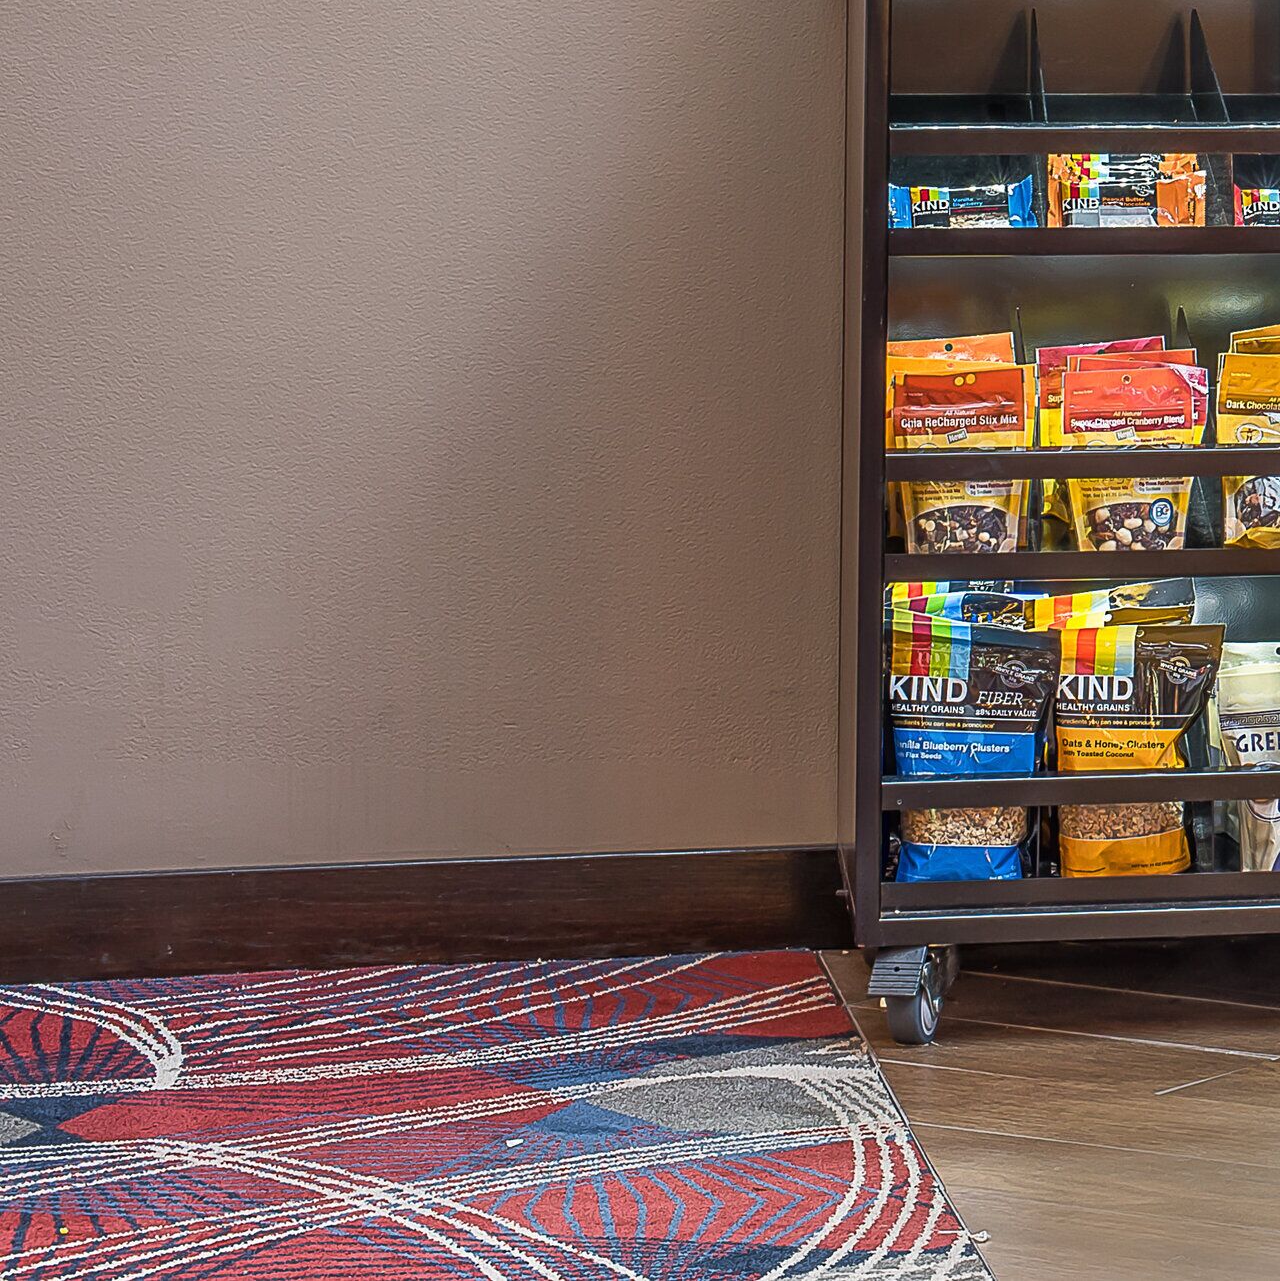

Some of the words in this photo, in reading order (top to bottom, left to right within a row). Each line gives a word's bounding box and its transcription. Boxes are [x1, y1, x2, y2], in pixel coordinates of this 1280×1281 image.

[912, 200, 950, 213] KIND
[1243, 202, 1280, 215] KIND
[1226, 400, 1246, 409] Dark
[925, 416, 977, 428] ReCharged
[979, 416, 997, 426] Stix
[1000, 414, 1018, 424] Mix
[1127, 417, 1162, 426] Cranberry
[1163, 415, 1186, 424] Blend
[1160, 662, 1177, 671] WHOLE
[1177, 666, 1198, 676] GRAINS
[889, 676, 968, 703] KIND
[1056, 675, 1134, 701] KIND
[975, 691, 1024, 706] FIBER
[892, 703, 930, 713] HEALTHY
[931, 704, 965, 714] GRAINS
[991, 709, 1013, 717] DAILY
[1014, 709, 1037, 717] VALUE
[1056, 703, 1096, 711] HEALTHY
[1096, 703, 1131, 712] GRAINS
[922, 741, 968, 753] Blueberry
[970, 743, 1010, 753] Clusters
[1062, 738, 1083, 748] Oats
[1085, 740, 1092, 748] &
[1095, 739, 1124, 750] Honey
[1126, 740, 1165, 749] Clusters
[920, 752, 943, 760] Seeds
[1076, 750, 1104, 758] Toasted
